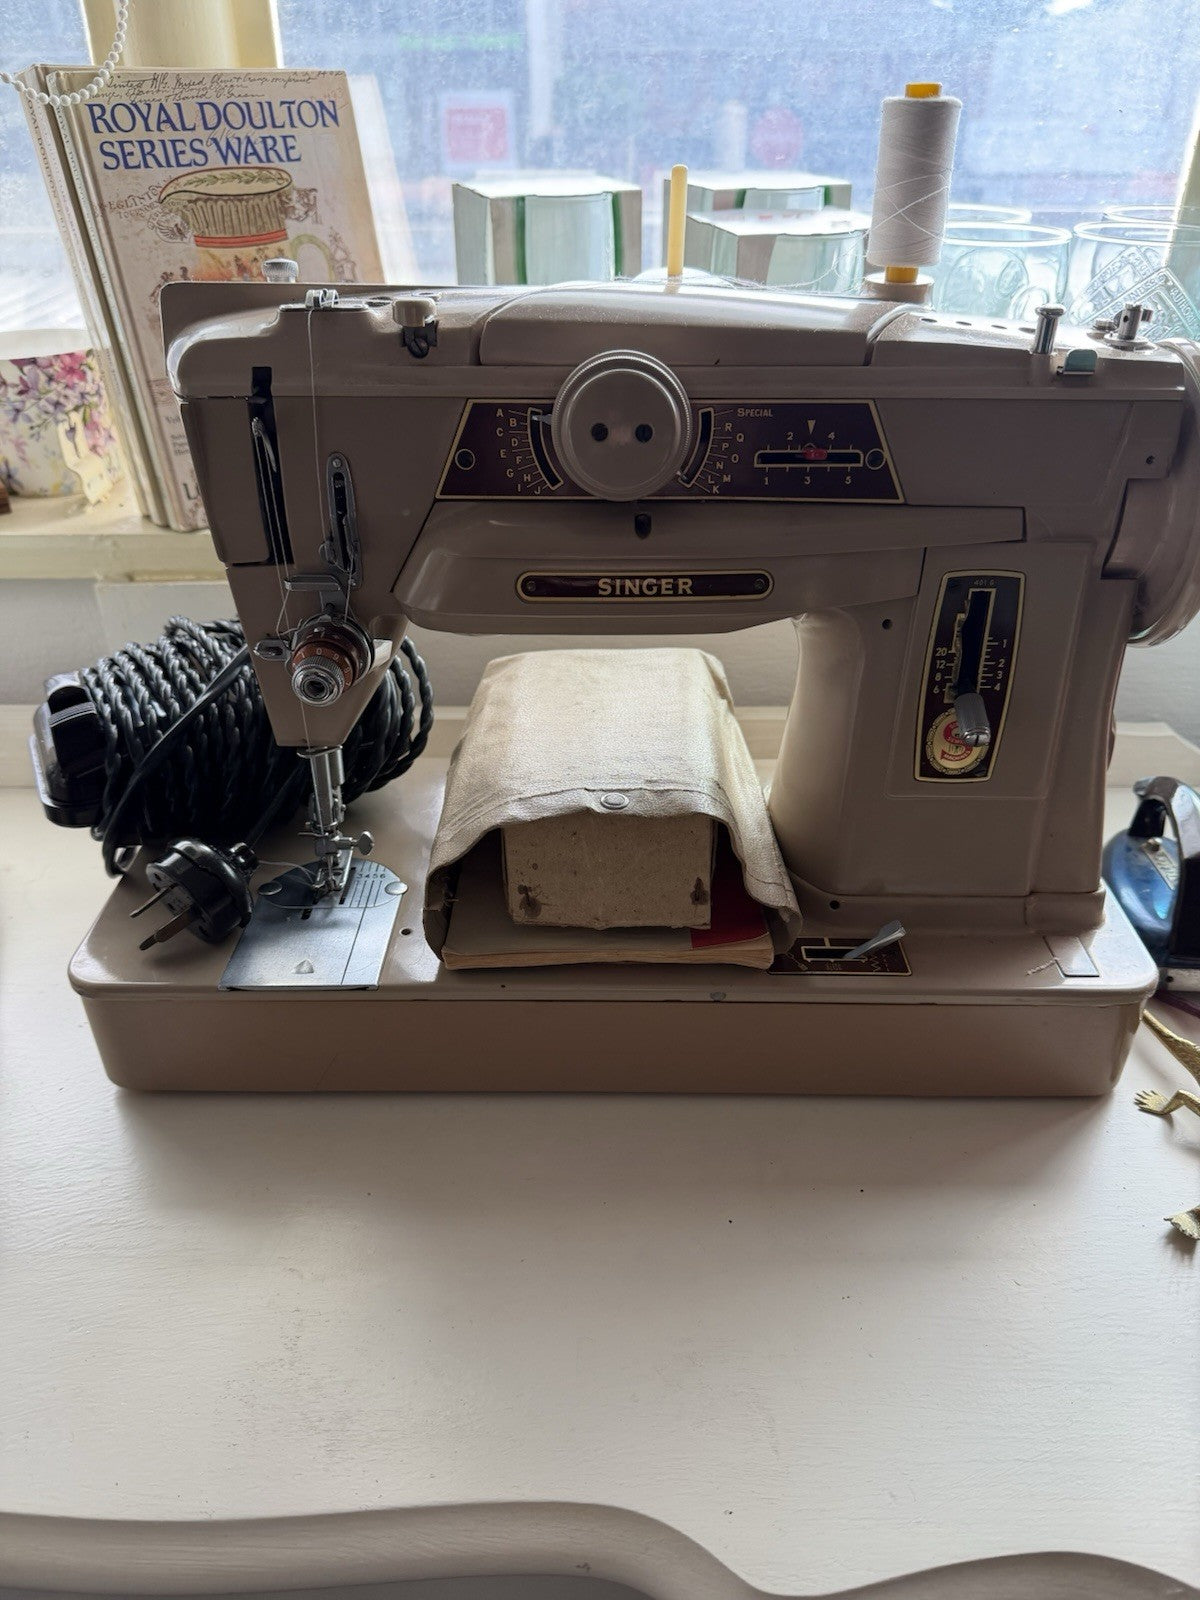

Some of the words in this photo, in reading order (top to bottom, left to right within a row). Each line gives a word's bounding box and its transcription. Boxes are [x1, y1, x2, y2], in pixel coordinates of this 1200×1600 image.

[86, 102, 196, 134] ROYAL
[198, 100, 340, 132] DOULTON
[99, 138, 208, 170] SERIES
[212, 134, 302, 166] WARE
[496, 408, 504, 418] A
[509, 418, 517, 427] B
[724, 422, 733, 431] R
[496, 427, 504, 437] C
[786, 432, 794, 441] 2
[827, 432, 836, 440] 4
[511, 438, 519, 446] D
[736, 433, 745, 443] Q
[722, 443, 730, 451] P
[499, 449, 507, 458] E
[516, 456, 523, 464] F
[731, 454, 739, 463] O
[716, 461, 724, 470] N
[506, 469, 514, 478] G
[523, 473, 532, 482] H
[708, 475, 715, 483] L
[723, 474, 732, 483] M
[763, 476, 769, 485] 1
[804, 476, 811, 485] 3
[844, 476, 852, 485] 5
[517, 484, 521, 492] I
[534, 486, 541, 495] J
[712, 485, 720, 494] K
[597, 577, 693, 596] SINGER
[1002, 639, 1008, 649] 1
[935, 647, 948, 657] 20
[935, 659, 946, 669] 12
[998, 658, 1005, 668] 2
[934, 672, 941, 681] 8
[996, 671, 1003, 680] 3
[933, 686, 940, 694] 6
[994, 682, 1001, 691] 4
